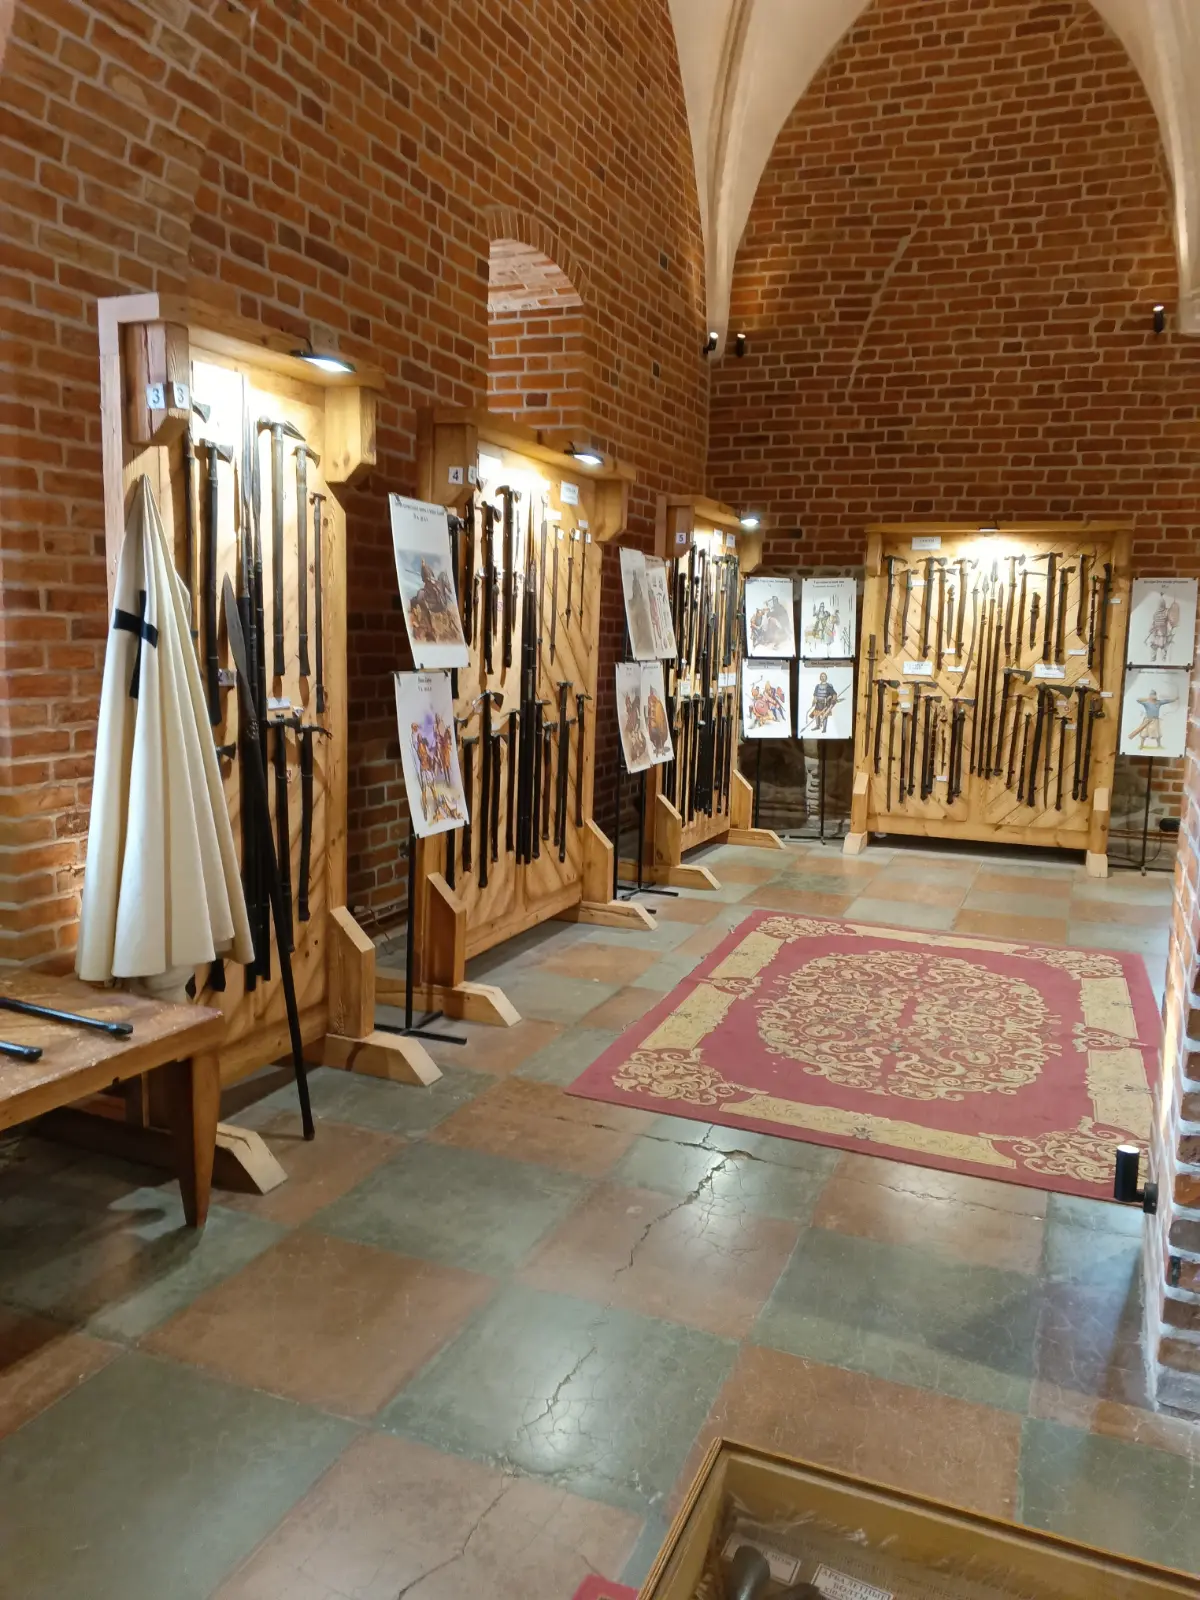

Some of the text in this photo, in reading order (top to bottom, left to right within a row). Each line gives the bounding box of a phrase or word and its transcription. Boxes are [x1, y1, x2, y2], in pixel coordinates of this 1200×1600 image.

[152, 387, 160, 404] 3
[177, 387, 184, 404] 3
[452, 469, 459, 481] 4
[821, 1570, 886, 1600] АРБАЛЕТНЫЕ
[832, 1582, 869, 1600] БОЛТЫ
